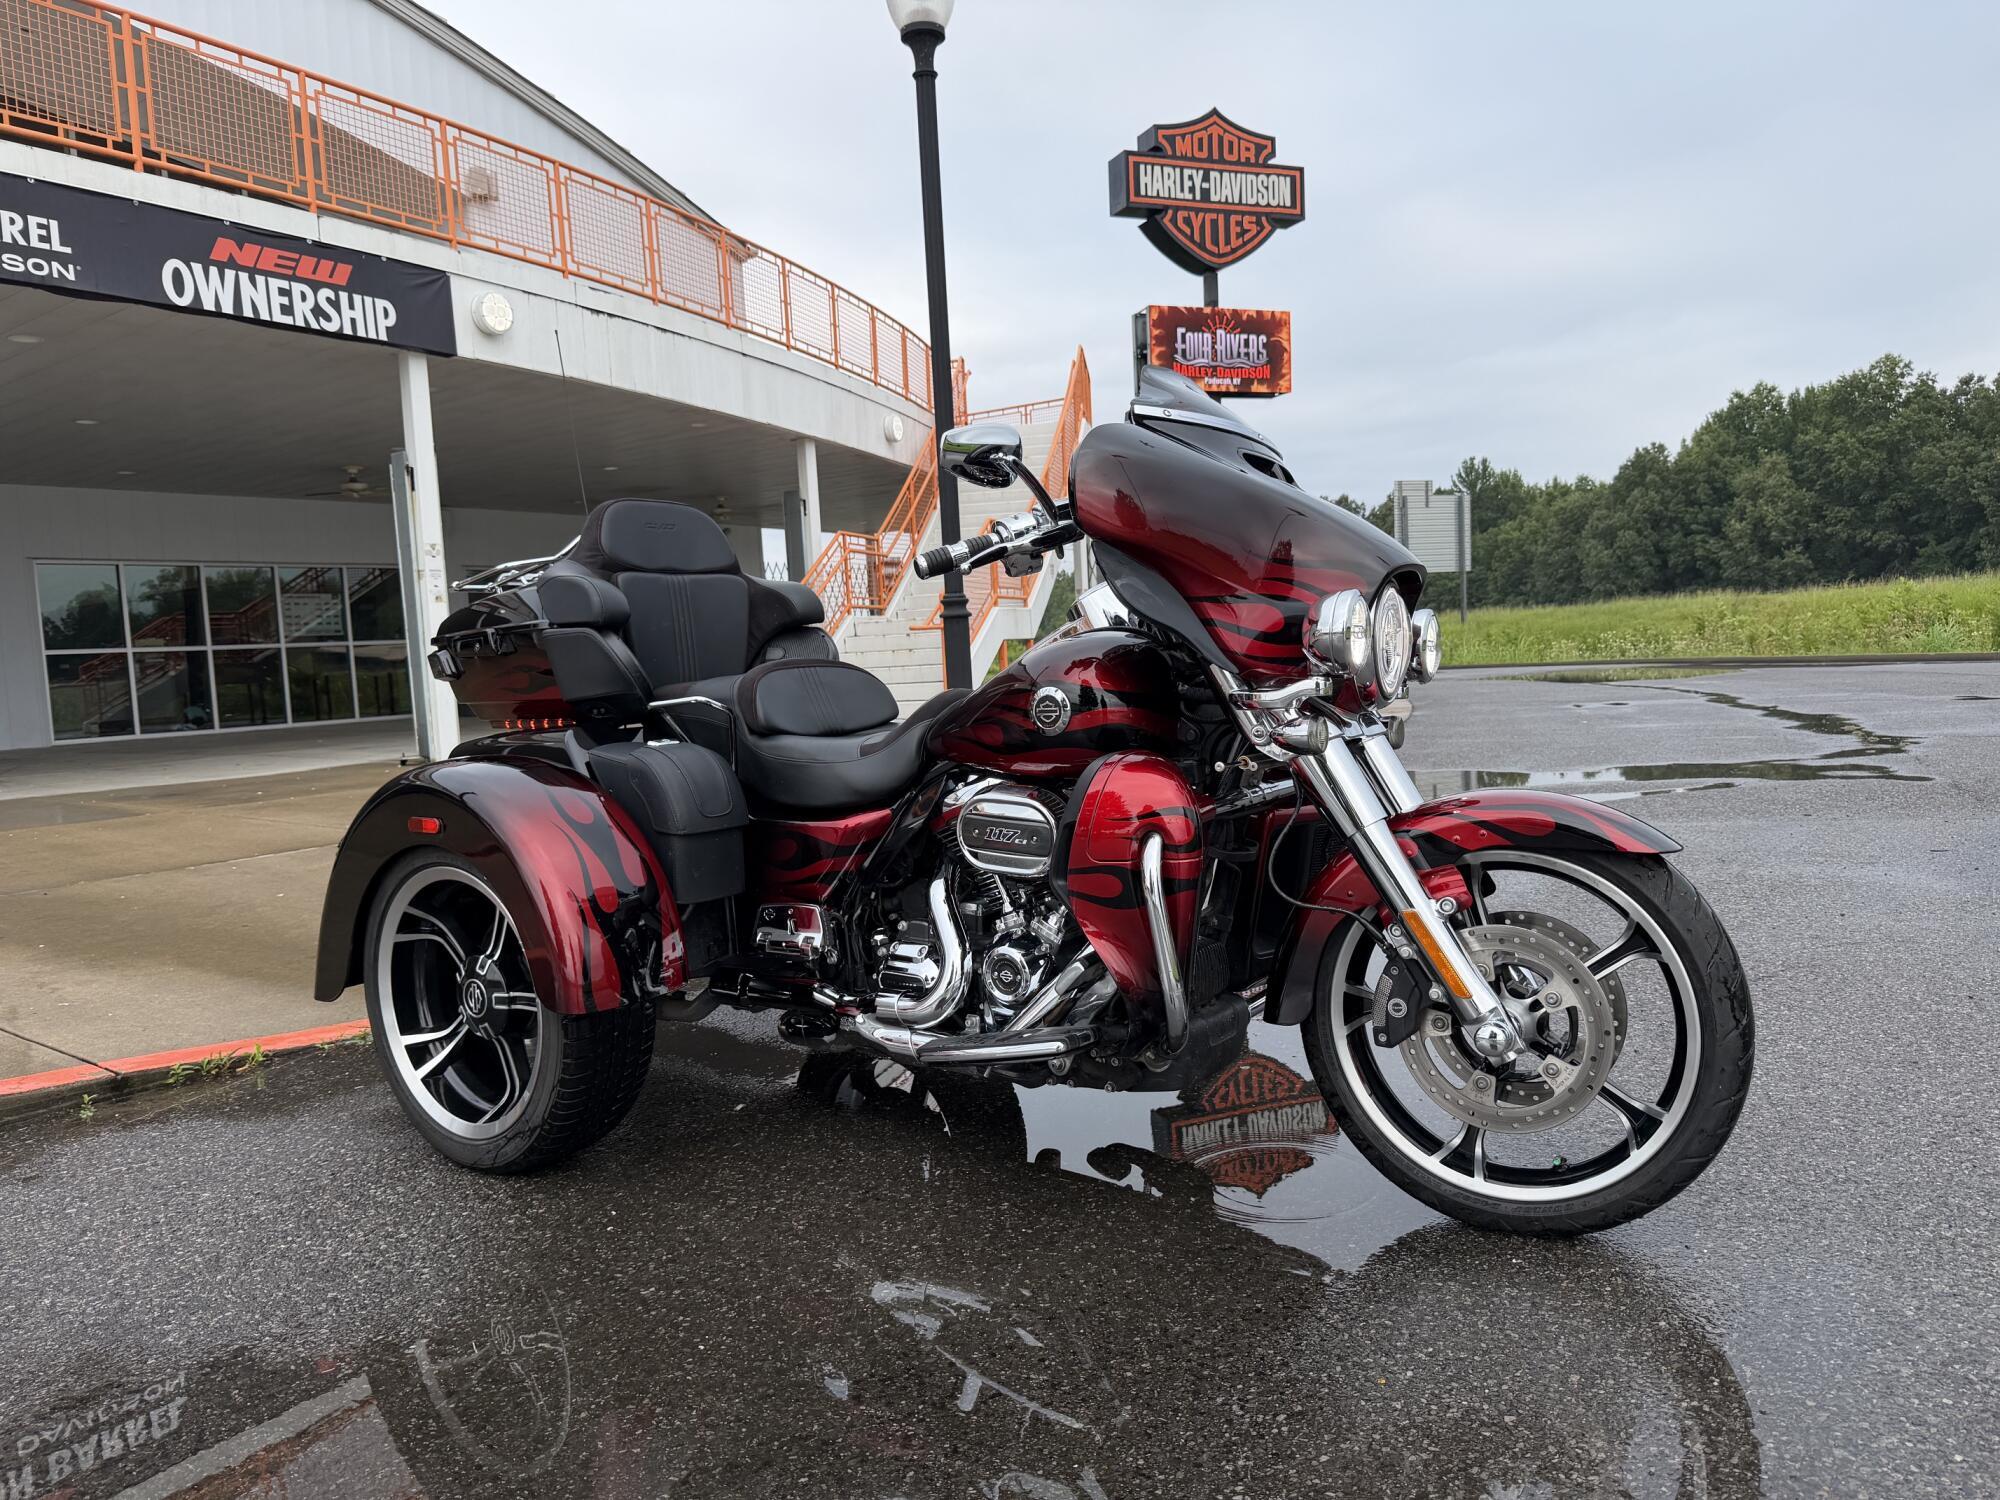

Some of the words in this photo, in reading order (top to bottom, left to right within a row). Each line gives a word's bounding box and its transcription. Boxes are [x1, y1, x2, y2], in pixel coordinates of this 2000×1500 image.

[1175, 125, 1255, 163] MOTOR
[1139, 163, 1291, 207] HARLEY-DAVIDSON
[1177, 210, 1257, 254] CYCLES
[209, 236, 352, 286] NEW
[161, 257, 397, 341] OWNERSHIP
[1175, 327, 1212, 361] FOUR
[1215, 329, 1268, 363] RIVERS
[1173, 362, 1271, 378] HARLEY-DAVIDSON
[984, 826, 1020, 843] 117
